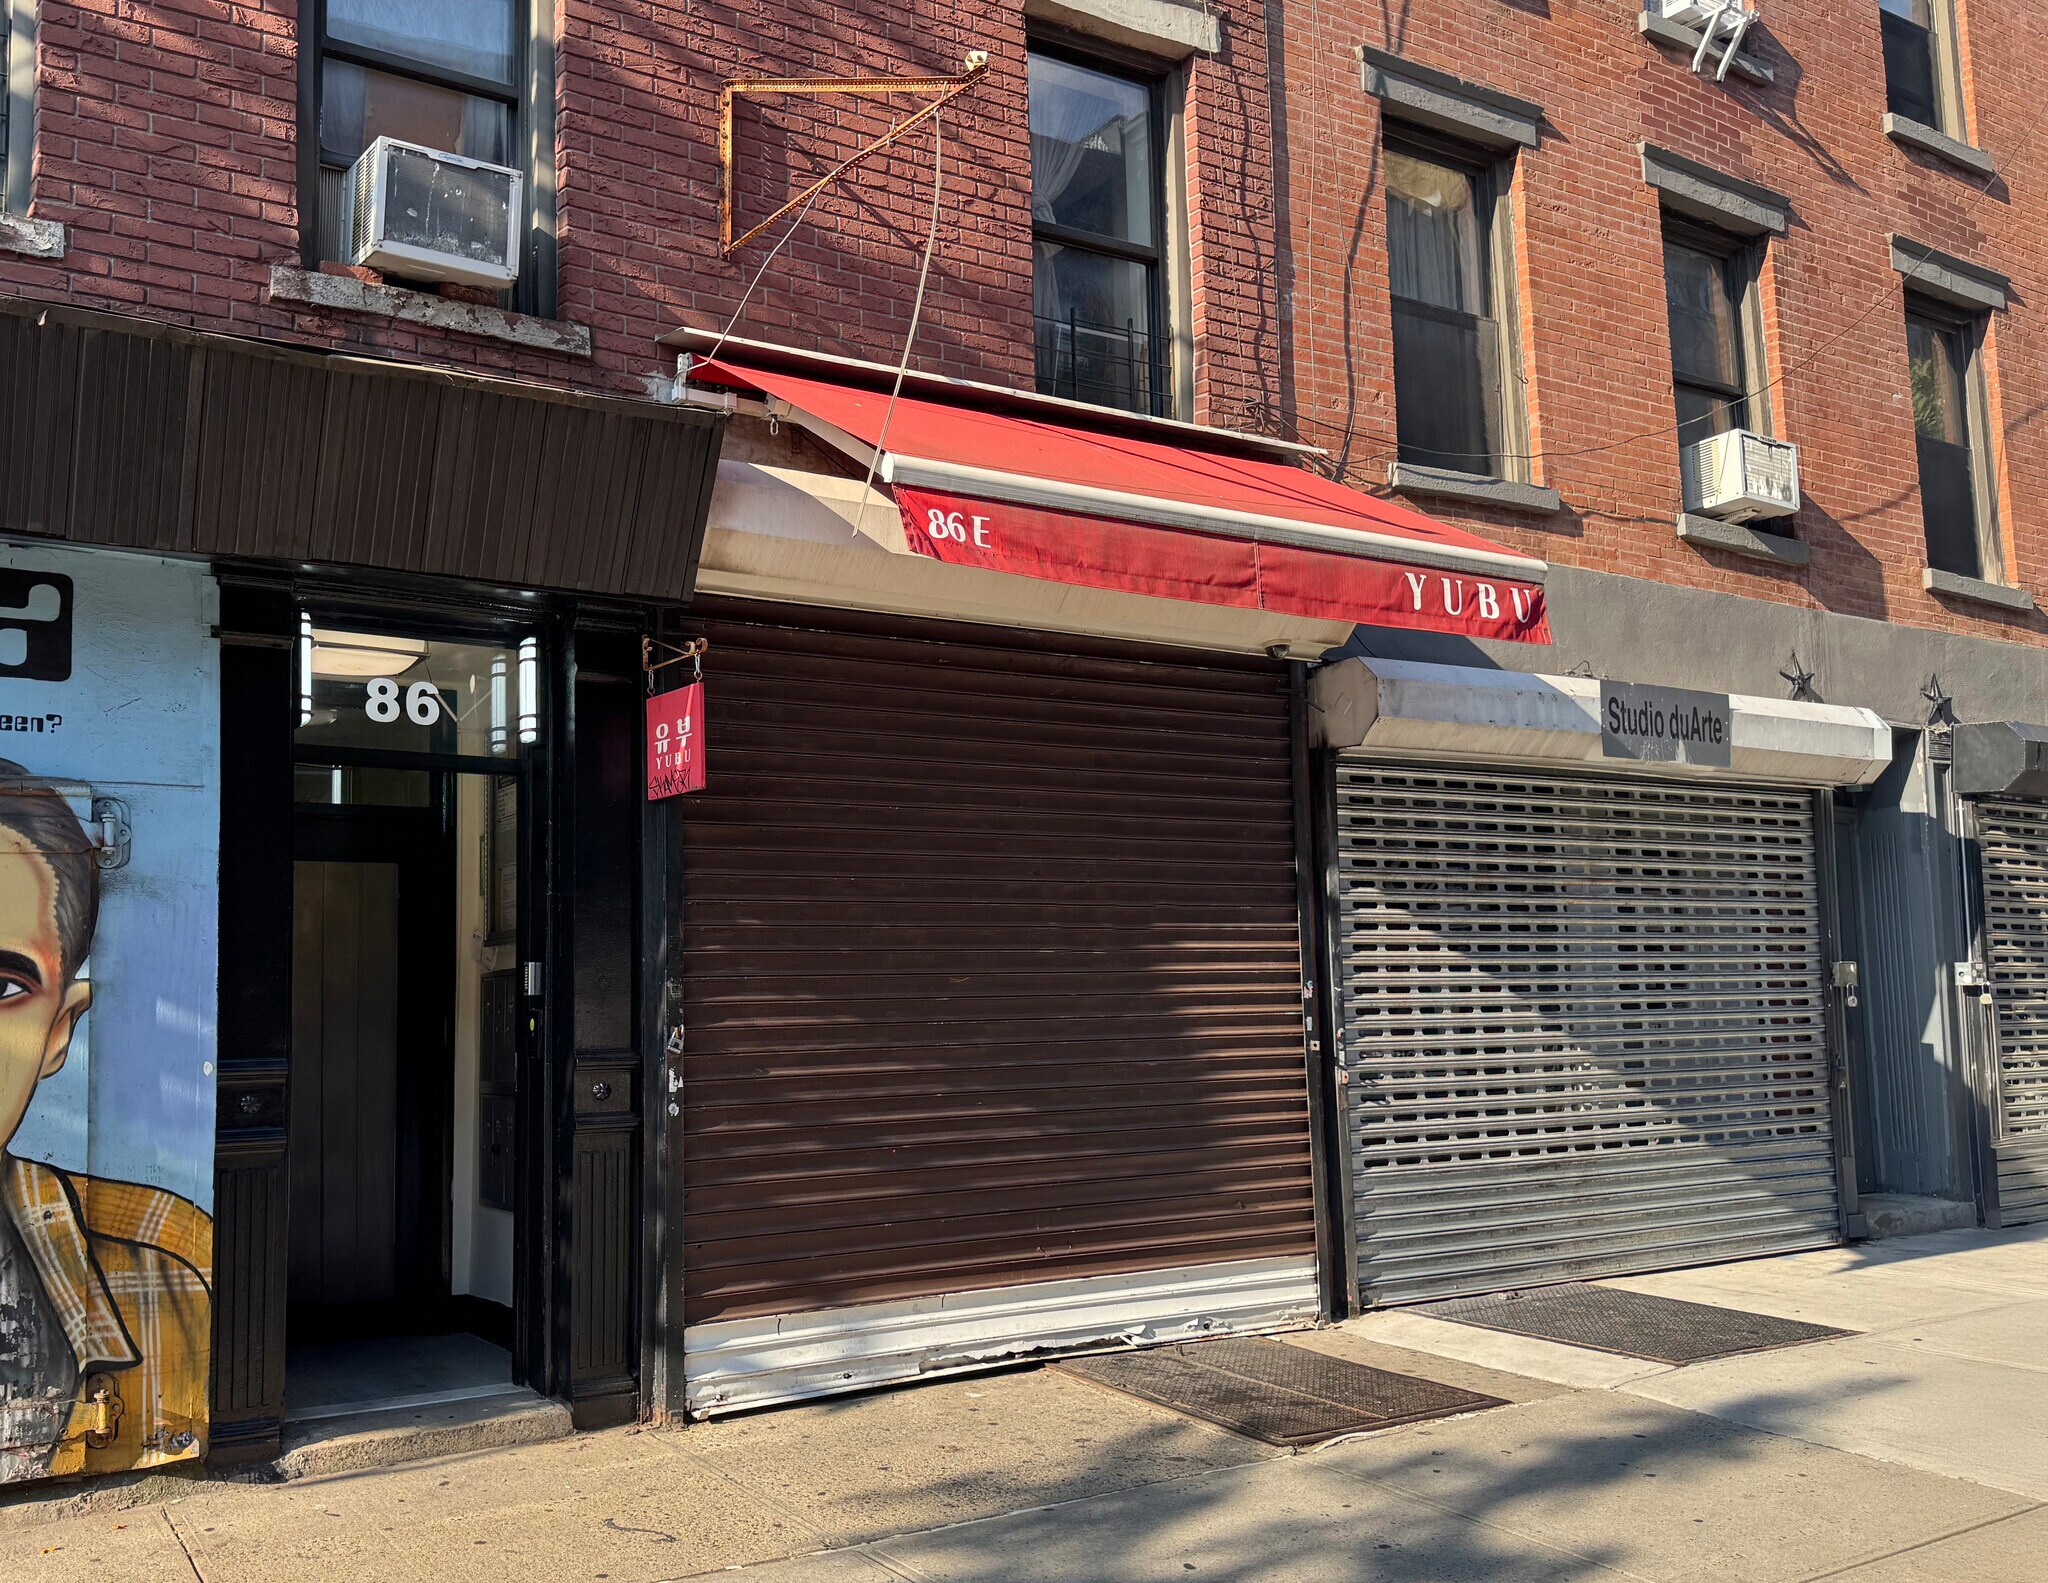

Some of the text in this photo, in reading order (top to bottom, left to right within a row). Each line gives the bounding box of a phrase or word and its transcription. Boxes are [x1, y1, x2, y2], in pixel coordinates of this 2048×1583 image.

[1404, 571, 1531, 623] YUBU
[365, 677, 440, 726] 86
[1608, 696, 1723, 745] Studio duArte
[654, 715, 693, 755] 유부
[656, 748, 692, 770] YUBU
